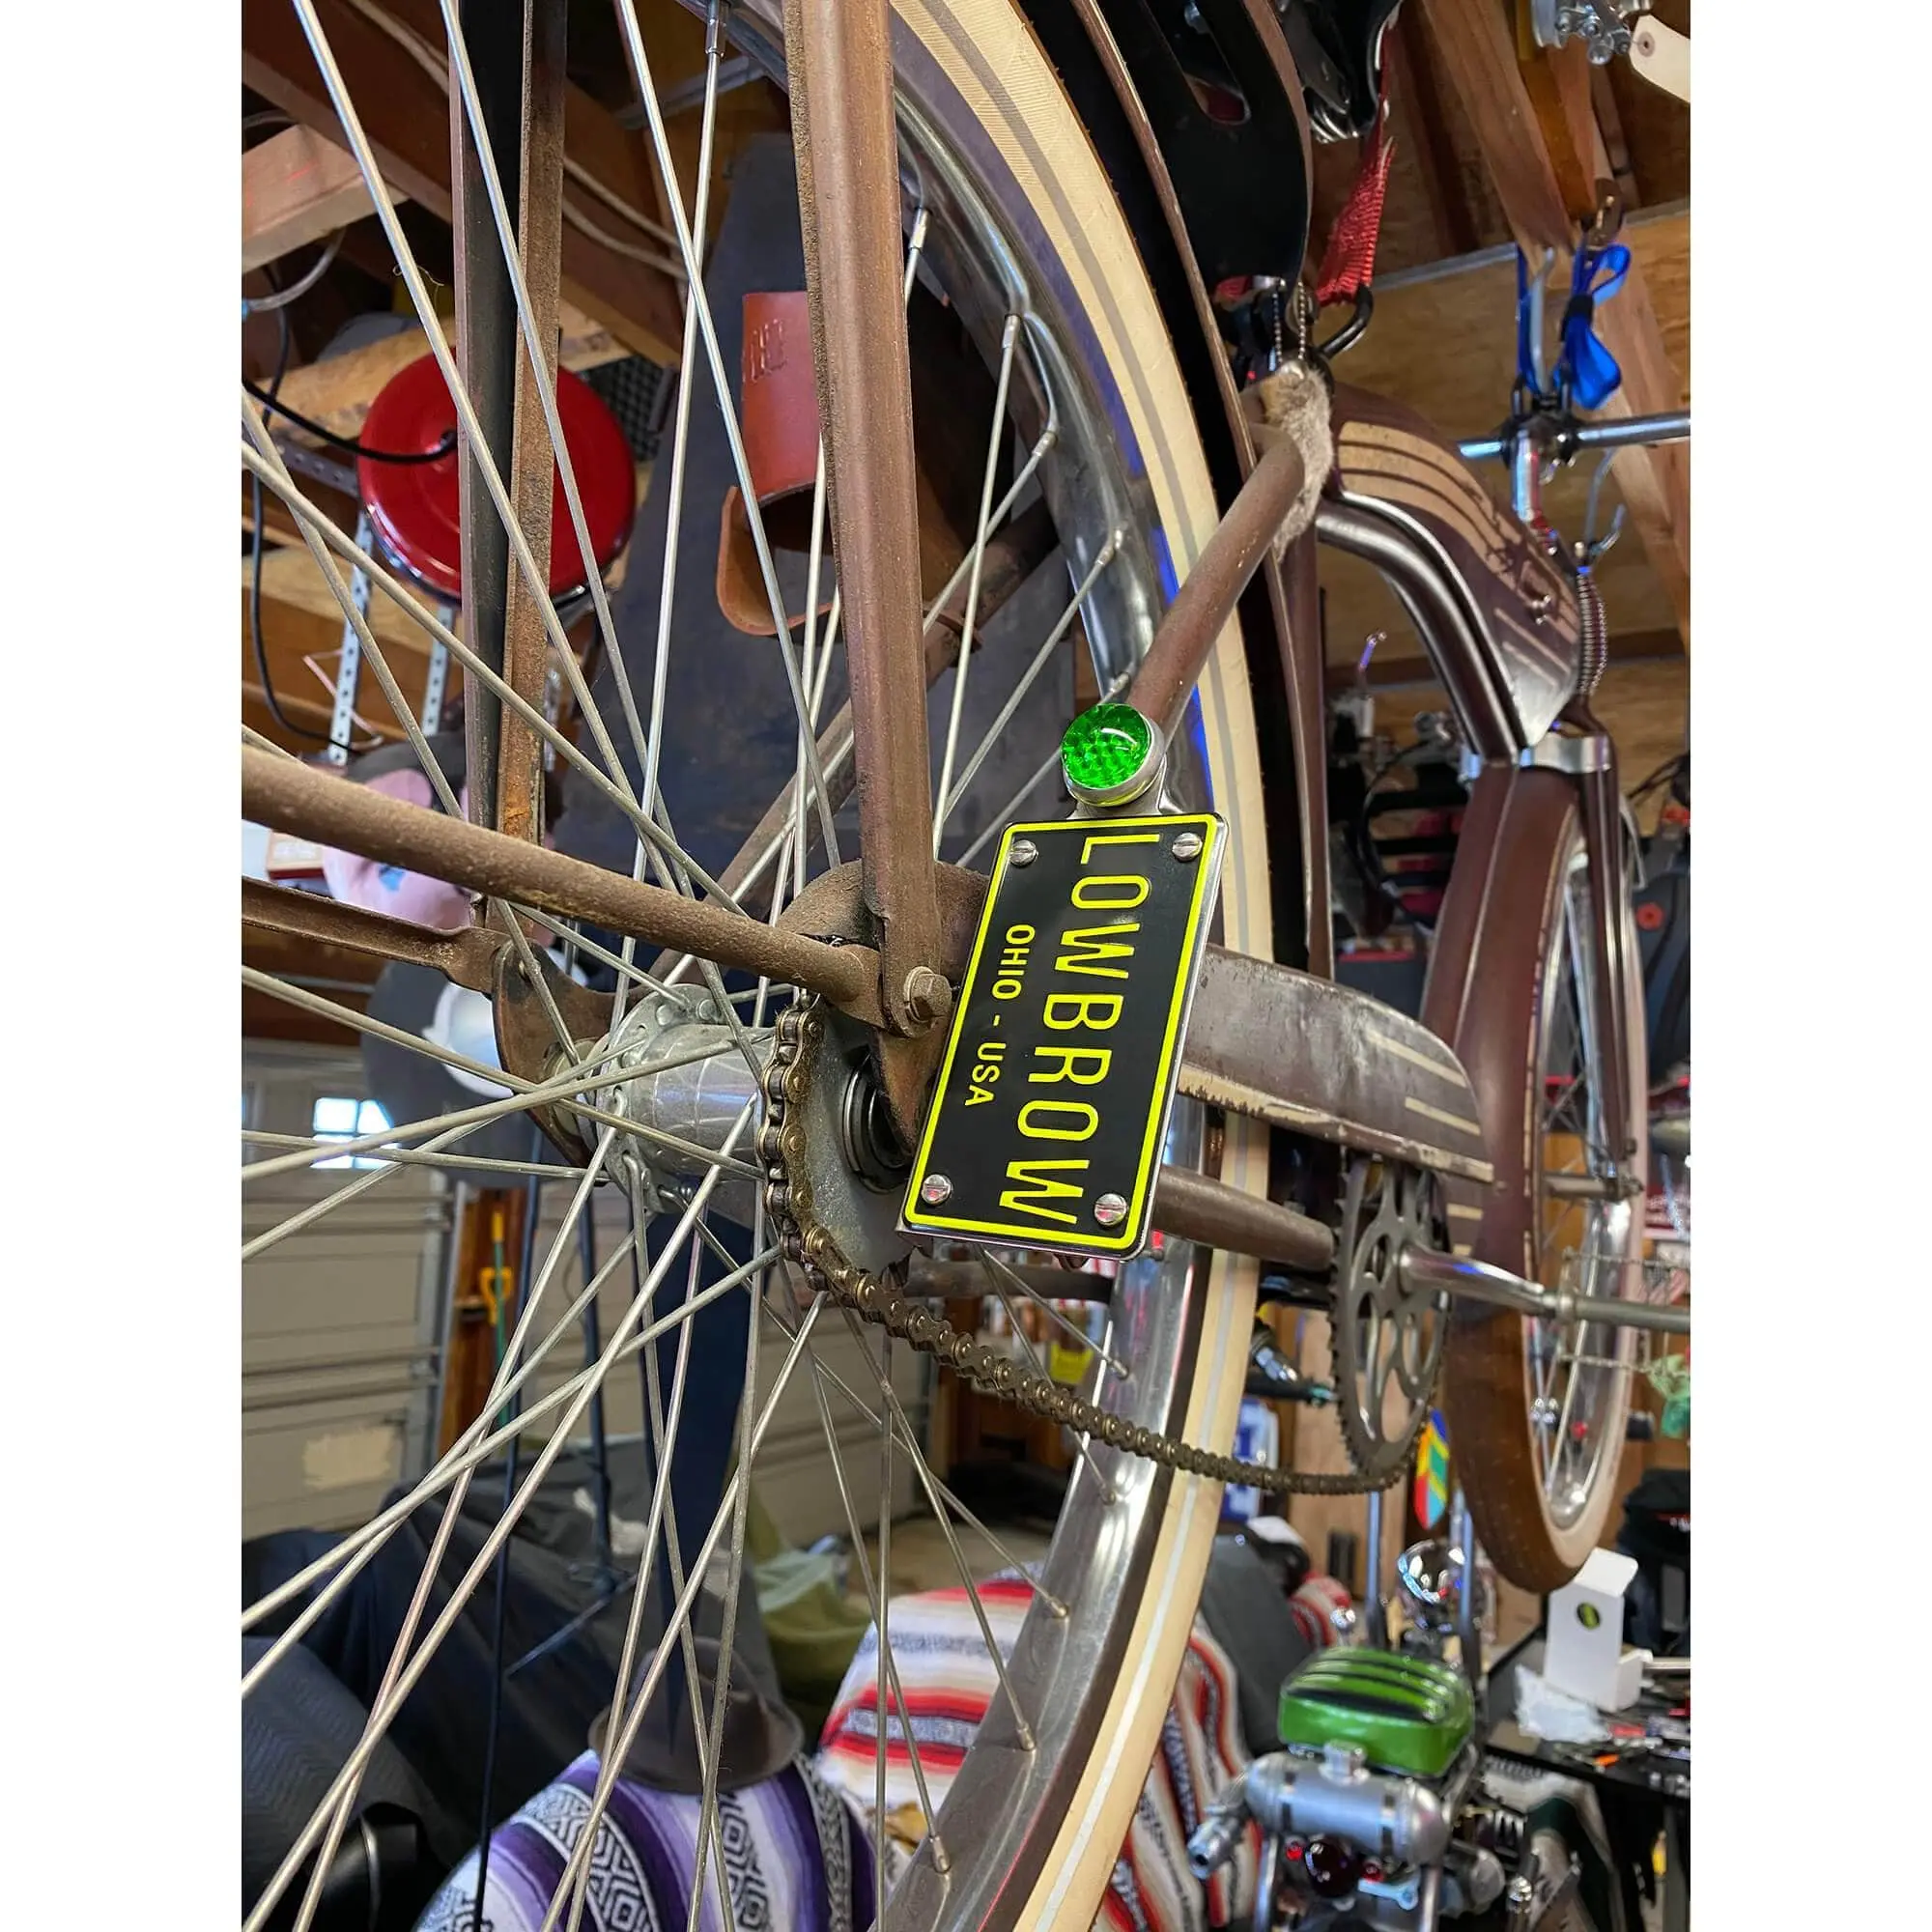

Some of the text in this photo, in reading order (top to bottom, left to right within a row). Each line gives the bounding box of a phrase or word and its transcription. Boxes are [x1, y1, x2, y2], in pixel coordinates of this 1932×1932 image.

[991, 923, 1037, 1000] OHIO
[999, 833, 1160, 1225] LOWBROW
[964, 1042, 1006, 1106] USA
